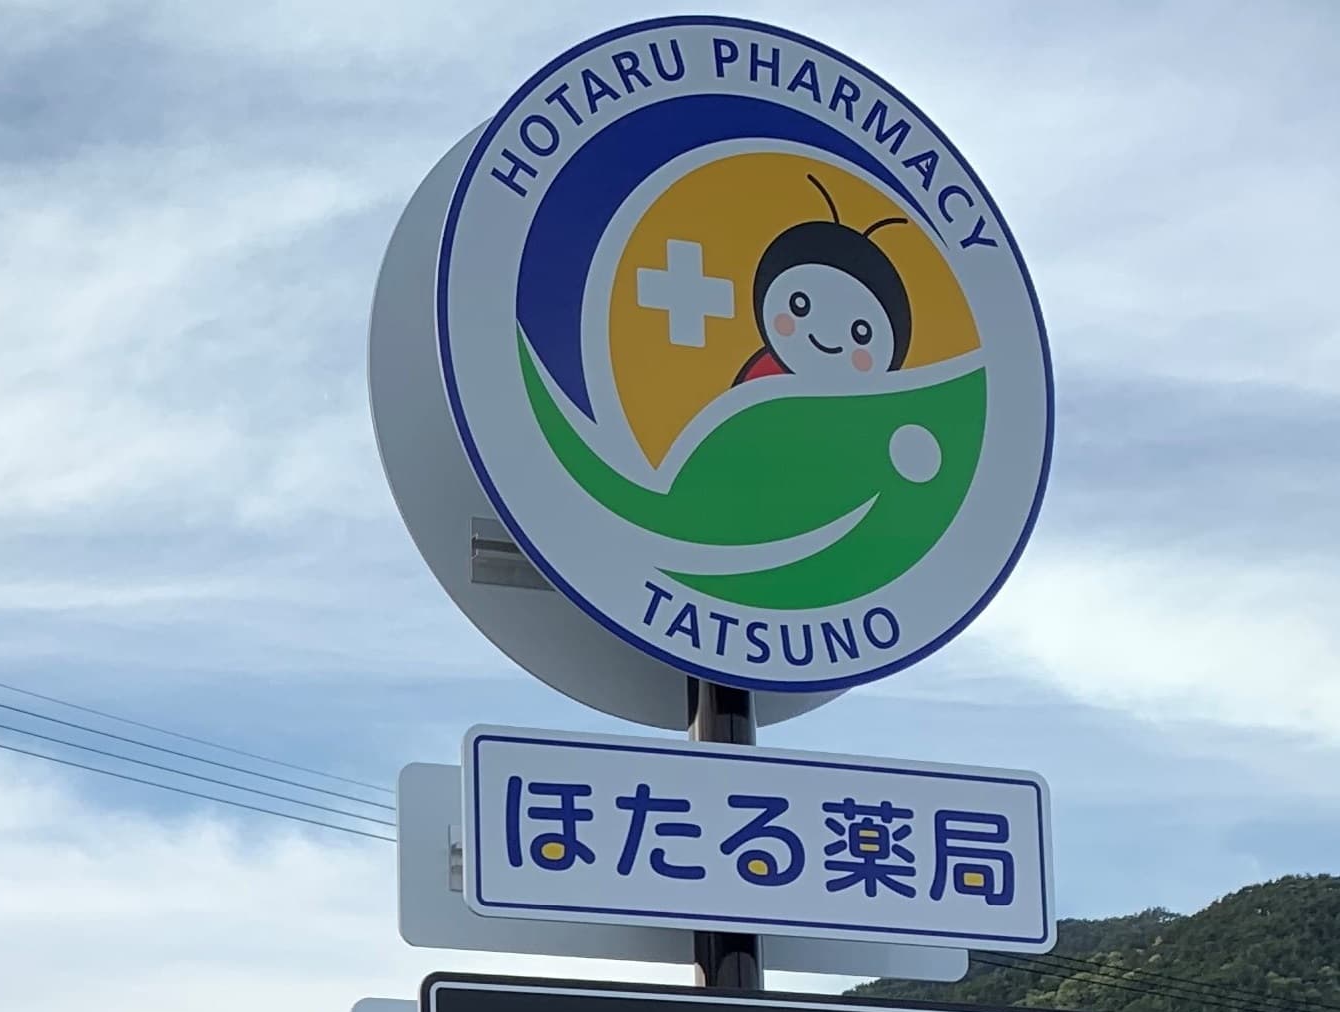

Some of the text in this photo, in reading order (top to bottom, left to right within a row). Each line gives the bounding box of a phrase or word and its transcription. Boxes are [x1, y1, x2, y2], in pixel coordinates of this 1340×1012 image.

[490, 38, 998, 253] HOTARU PHARMACY
[642, 581, 901, 667] TATSUNO
[505, 775, 1016, 906] ほたる薬局
